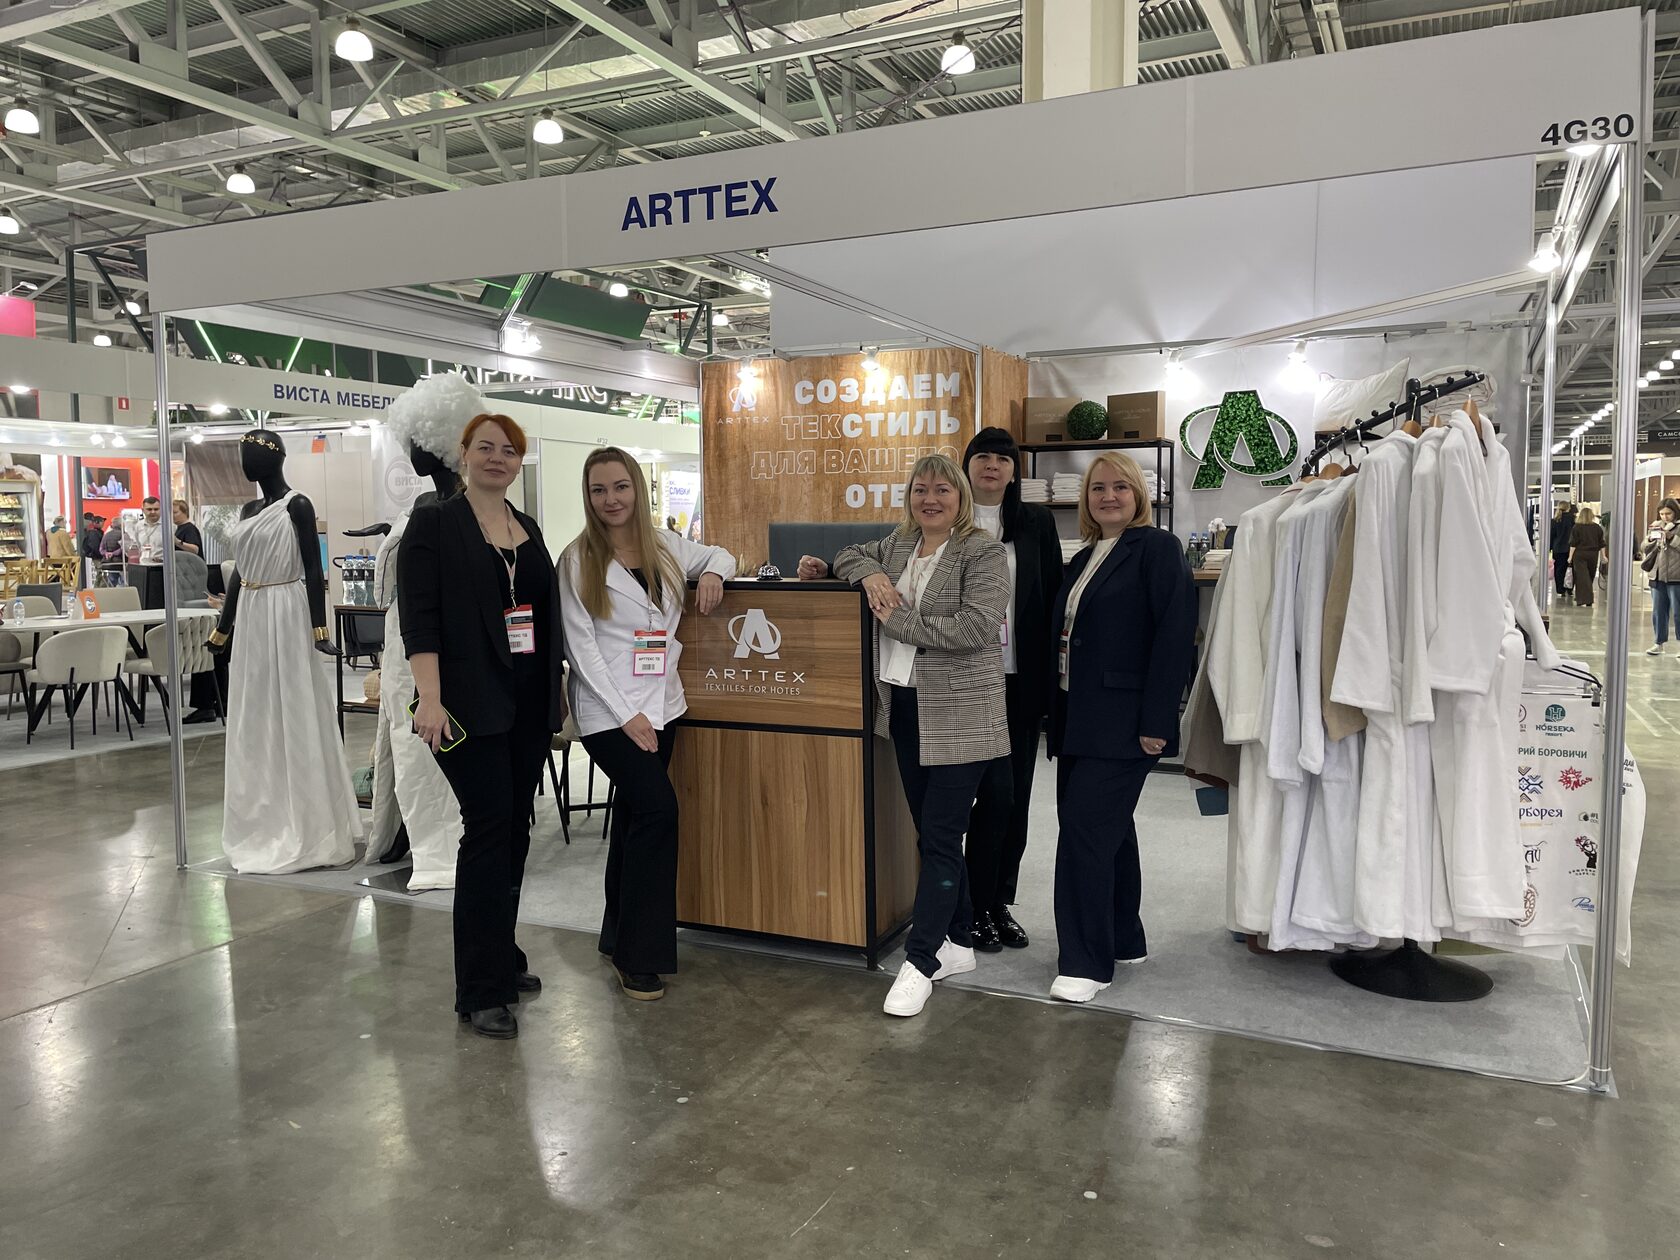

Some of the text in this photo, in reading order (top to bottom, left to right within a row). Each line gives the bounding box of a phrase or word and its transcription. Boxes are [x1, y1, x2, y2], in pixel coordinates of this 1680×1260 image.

[1541, 113, 1634, 146] 4G30
[621, 176, 779, 231] ARTTEX
[273, 383, 331, 404] ВИСТА
[795, 372, 960, 406] СОЗДАЕМ
[717, 416, 769, 425] ARTTEX
[781, 409, 960, 440] ТЕКСТИЛЬ
[751, 450, 817, 479] ДЛЯ
[705, 668, 805, 683] ARTTEX
[705, 683, 800, 696] TEXTILES FOR HOTES
[1518, 746, 1588, 759] РИЙ БОРОВИЧИ
